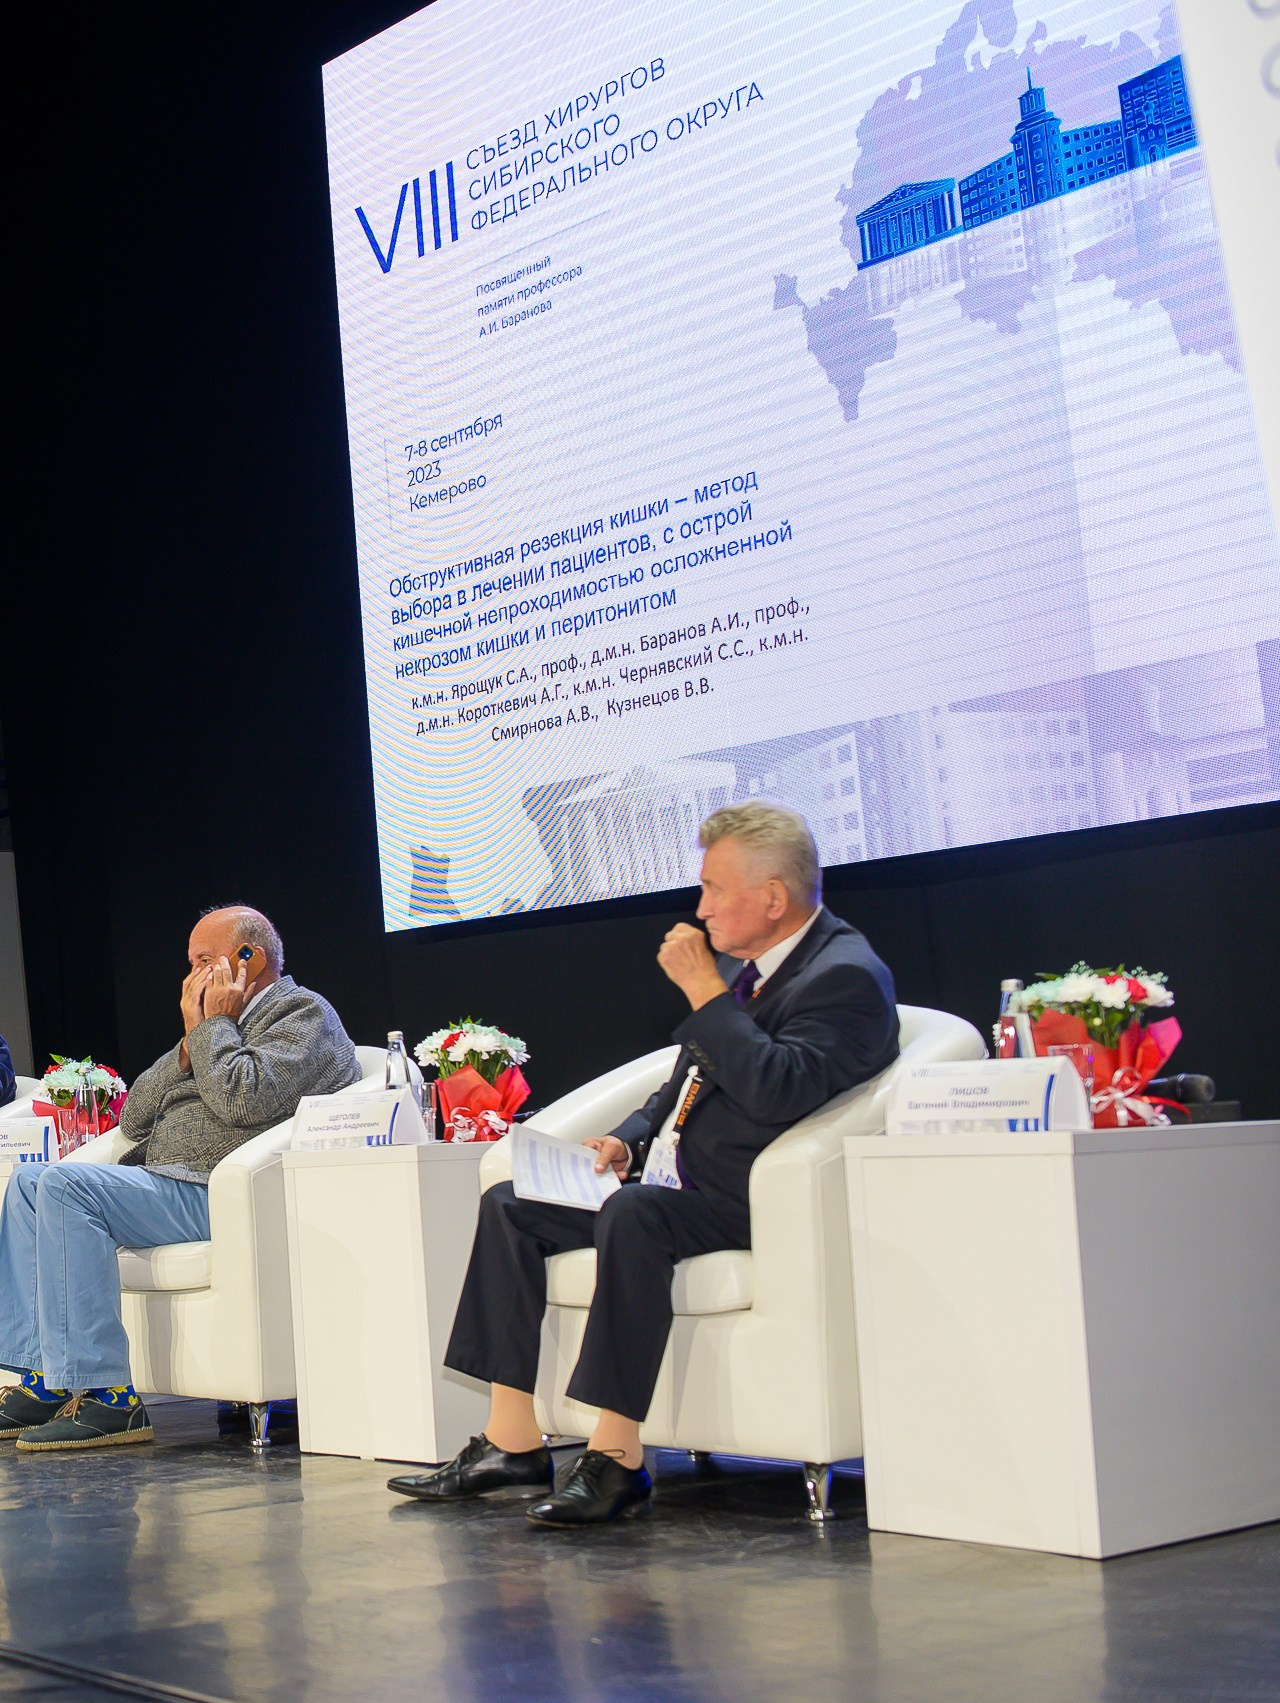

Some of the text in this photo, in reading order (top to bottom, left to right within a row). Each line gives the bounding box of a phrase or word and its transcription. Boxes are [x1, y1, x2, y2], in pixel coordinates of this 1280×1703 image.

[466, 58, 665, 170] СЪЕЗД ХИРУРГОВ
[469, 114, 621, 200] СИБИРСКОГО
[471, 82, 764, 231] ФЕДЕРАЛЬНОГО ОКРУГА
[355, 162, 458, 273] VIII
[476, 256, 551, 297] Посвященный
[478, 265, 582, 317] памяти профессора
[502, 300, 552, 330] Баранова
[405, 413, 503, 461] 7-8 сентября
[407, 460, 441, 488] 2023
[390, 547, 514, 597] Обструктивная
[520, 519, 603, 562] резекция
[610, 498, 668, 528] кишки
[694, 470, 758, 505] метод
[409, 474, 486, 512] Кемерово
[391, 501, 752, 625] выбора в лечении пациентов, с острой
[393, 521, 792, 651] кишечной непроходимостью осложненной
[395, 589, 676, 680] некрозом кишки и перитонитом
[411, 596, 810, 710] к.м.н. Ярощук С.А., проф., д.м.н. Баранов А.И., проф.,
[416, 713, 454, 737] д.м.н.
[457, 693, 537, 724] Короткевич
[573, 676, 615, 696] к.м.н.
[619, 646, 712, 684] Чернявский
[759, 628, 808, 651] к.м.н.
[492, 714, 563, 742] Смирнова
[606, 685, 679, 717] Кузнецов
[684, 679, 713, 698] В.В.
